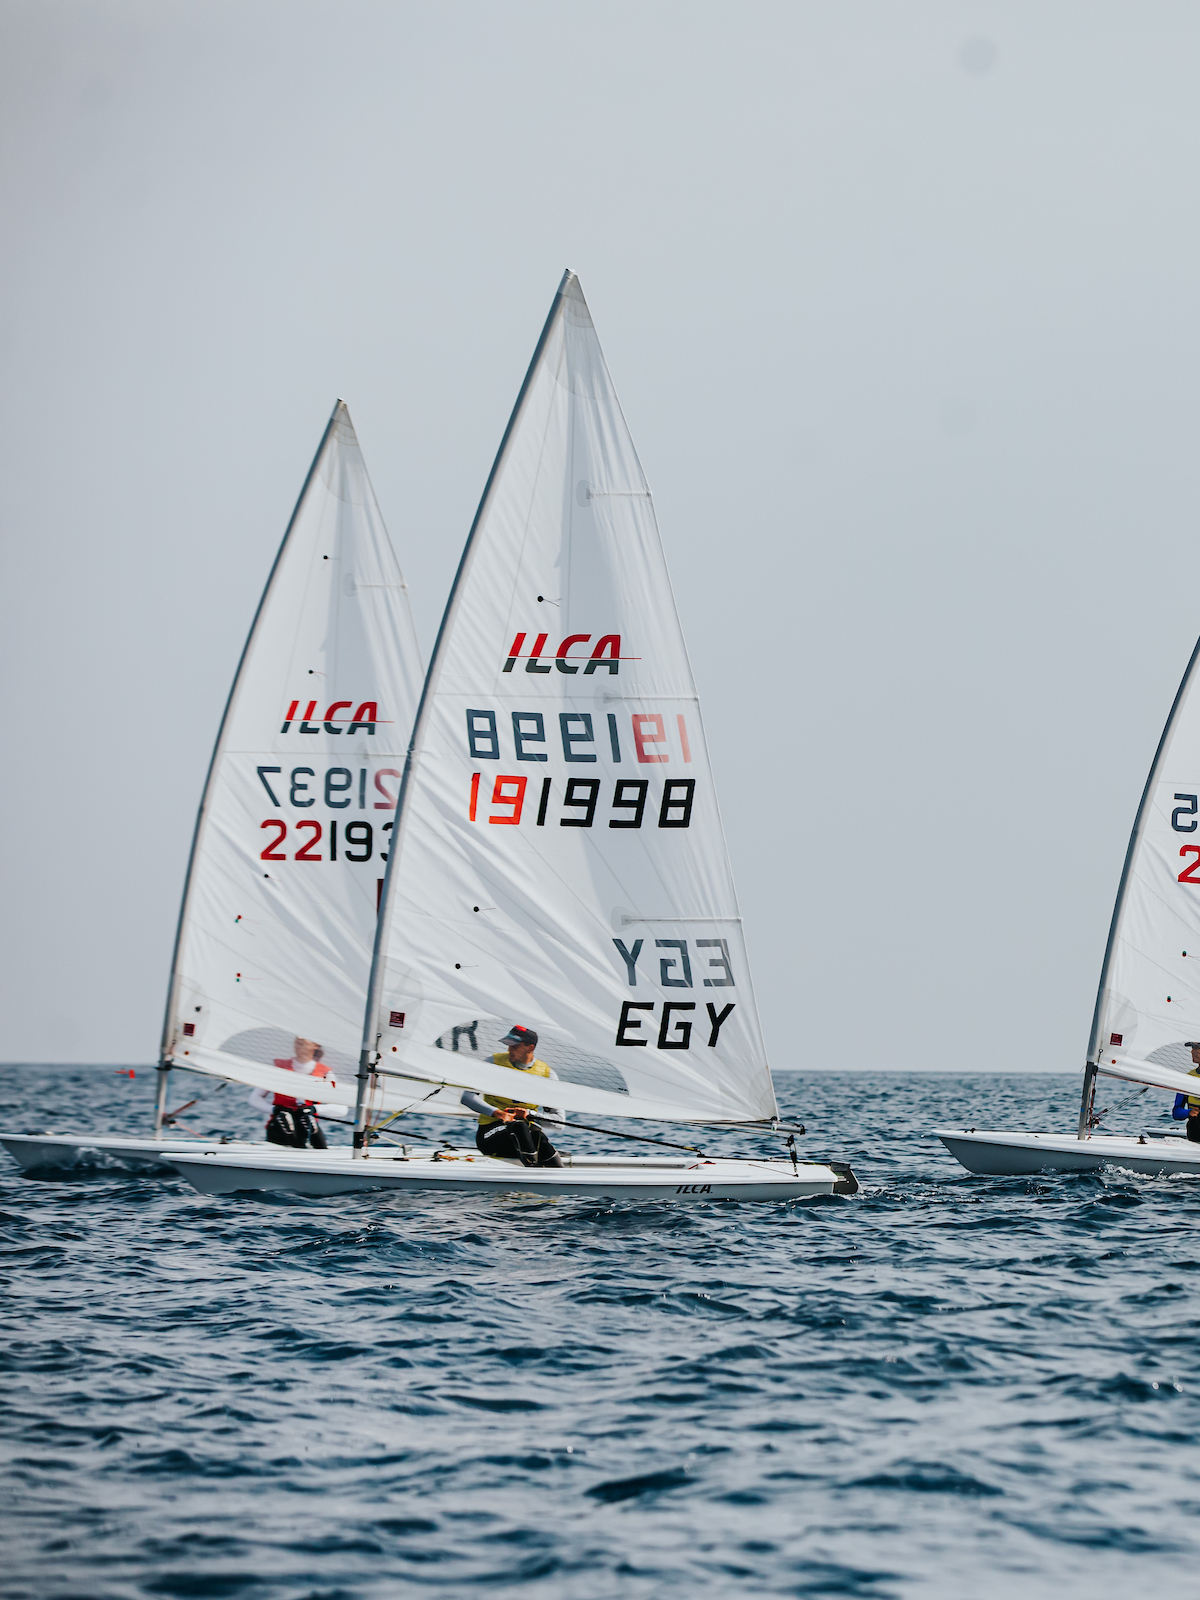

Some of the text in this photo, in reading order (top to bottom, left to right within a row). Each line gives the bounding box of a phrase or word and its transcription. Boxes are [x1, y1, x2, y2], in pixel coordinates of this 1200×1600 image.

[502, 633, 621, 675] ILCA
[280, 700, 378, 735] ILCA
[469, 772, 696, 828] 191998
[615, 1000, 736, 1050] EGY
